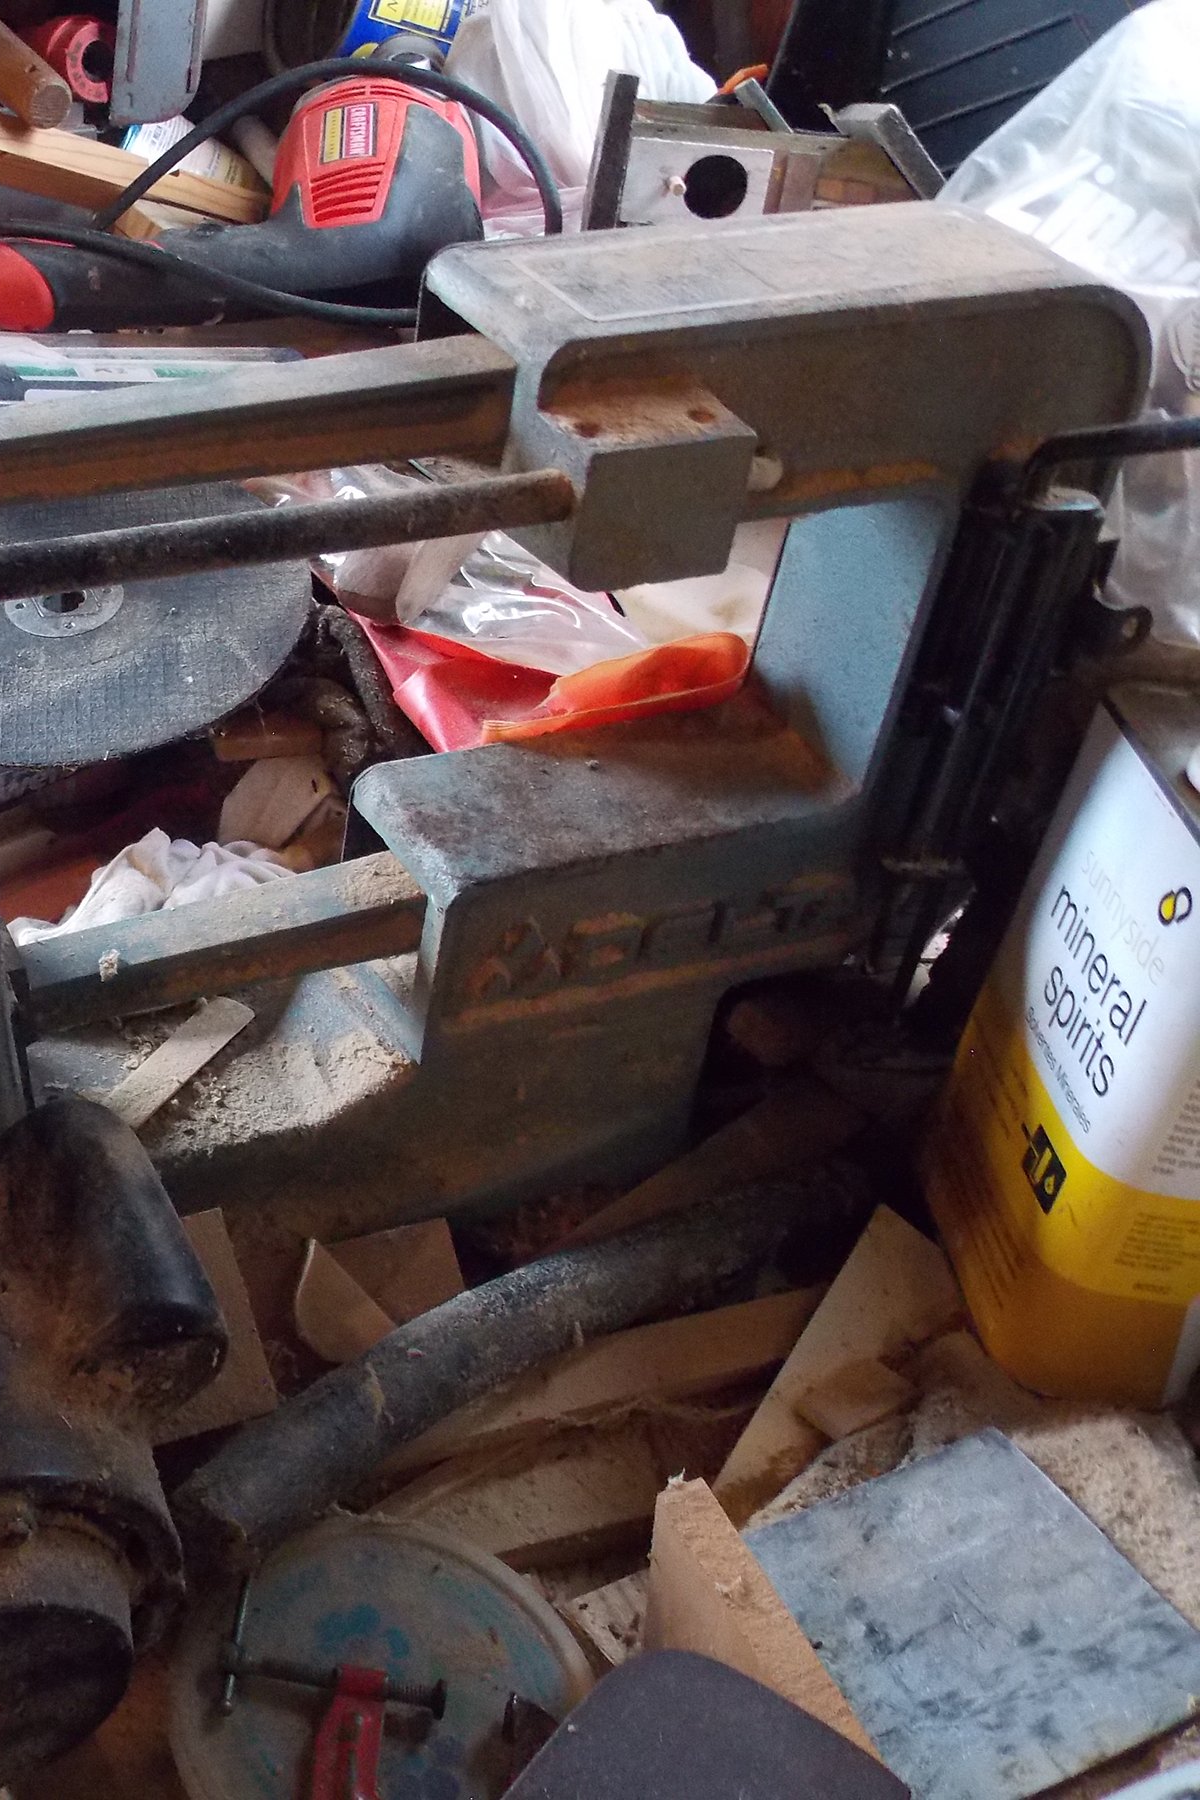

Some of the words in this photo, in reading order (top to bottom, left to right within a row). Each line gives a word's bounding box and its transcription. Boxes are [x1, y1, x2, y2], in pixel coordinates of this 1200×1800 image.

[349, 106, 368, 155] CRAFTSMAN
[1050, 884, 1148, 1047] mineral
[1081, 849, 1166, 986] sunnyside
[1043, 965, 1116, 1098] spirits
[1055, 1064, 1092, 1134] Minerales
